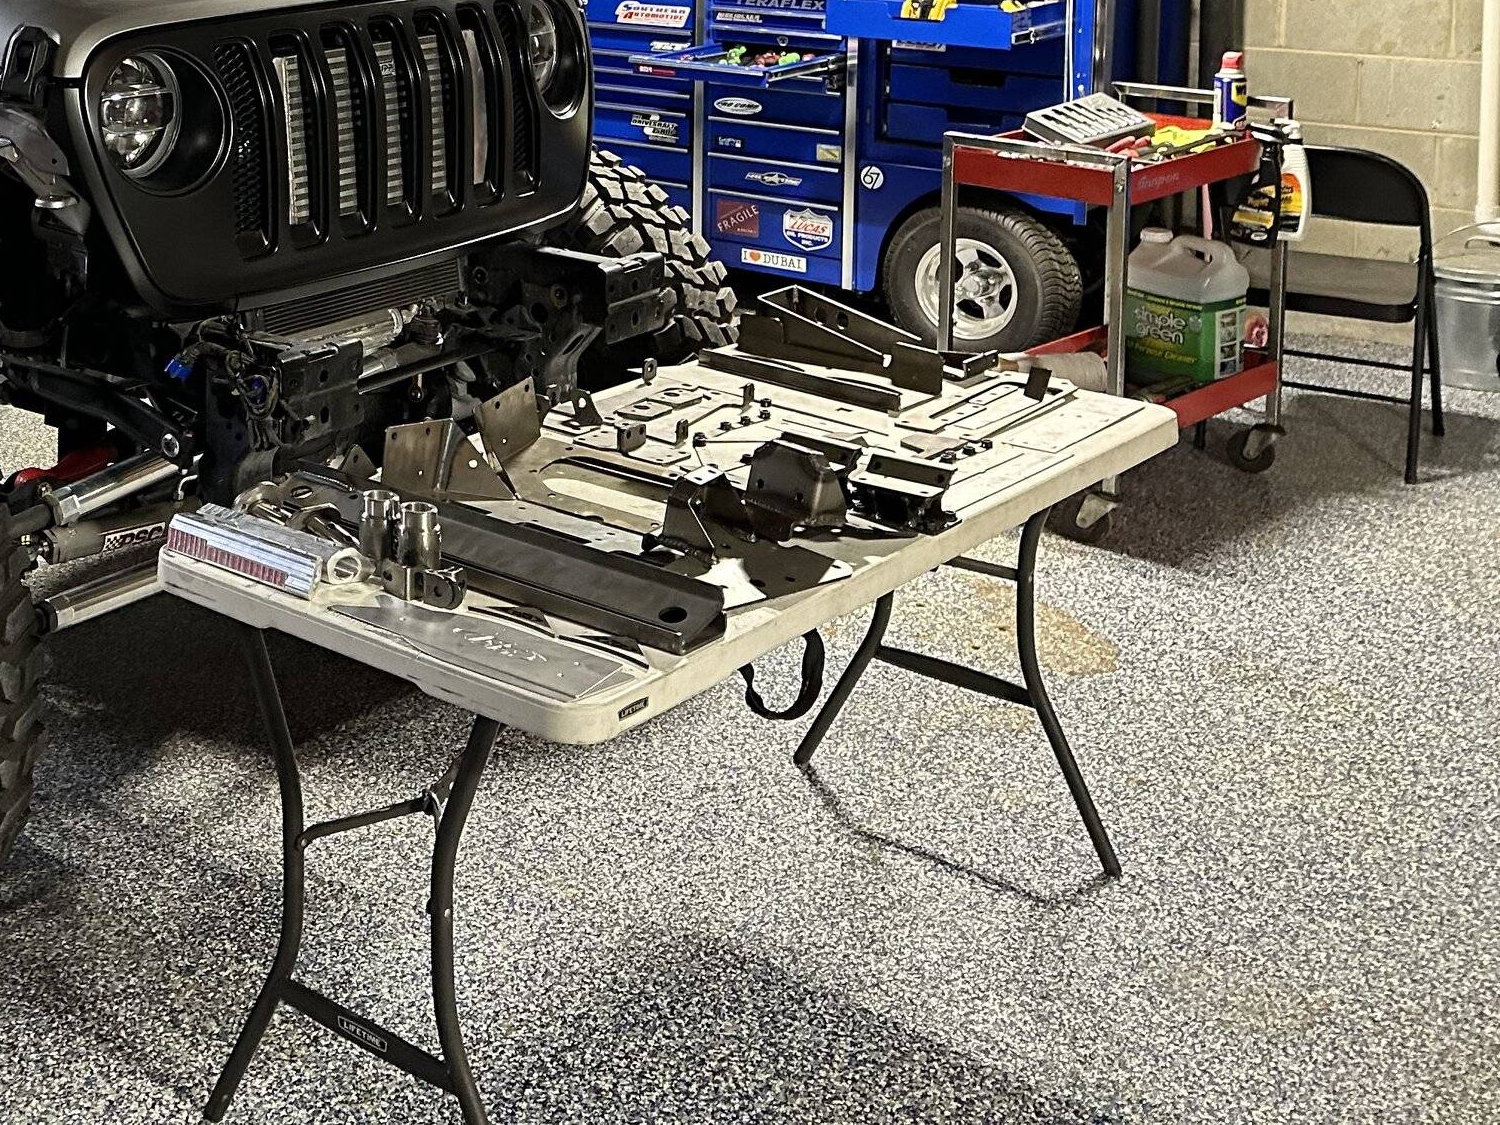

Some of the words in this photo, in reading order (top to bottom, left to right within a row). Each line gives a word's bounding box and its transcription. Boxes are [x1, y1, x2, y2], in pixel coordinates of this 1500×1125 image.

[862, 166, 880, 190] 67
[717, 203, 760, 233] FRAGILE
[789, 219, 829, 235] LUCAS
[743, 250, 748, 261] I
[763, 254, 804, 270] DUBAI
[1135, 306, 1187, 330] simple
[1136, 322, 1185, 345] green
